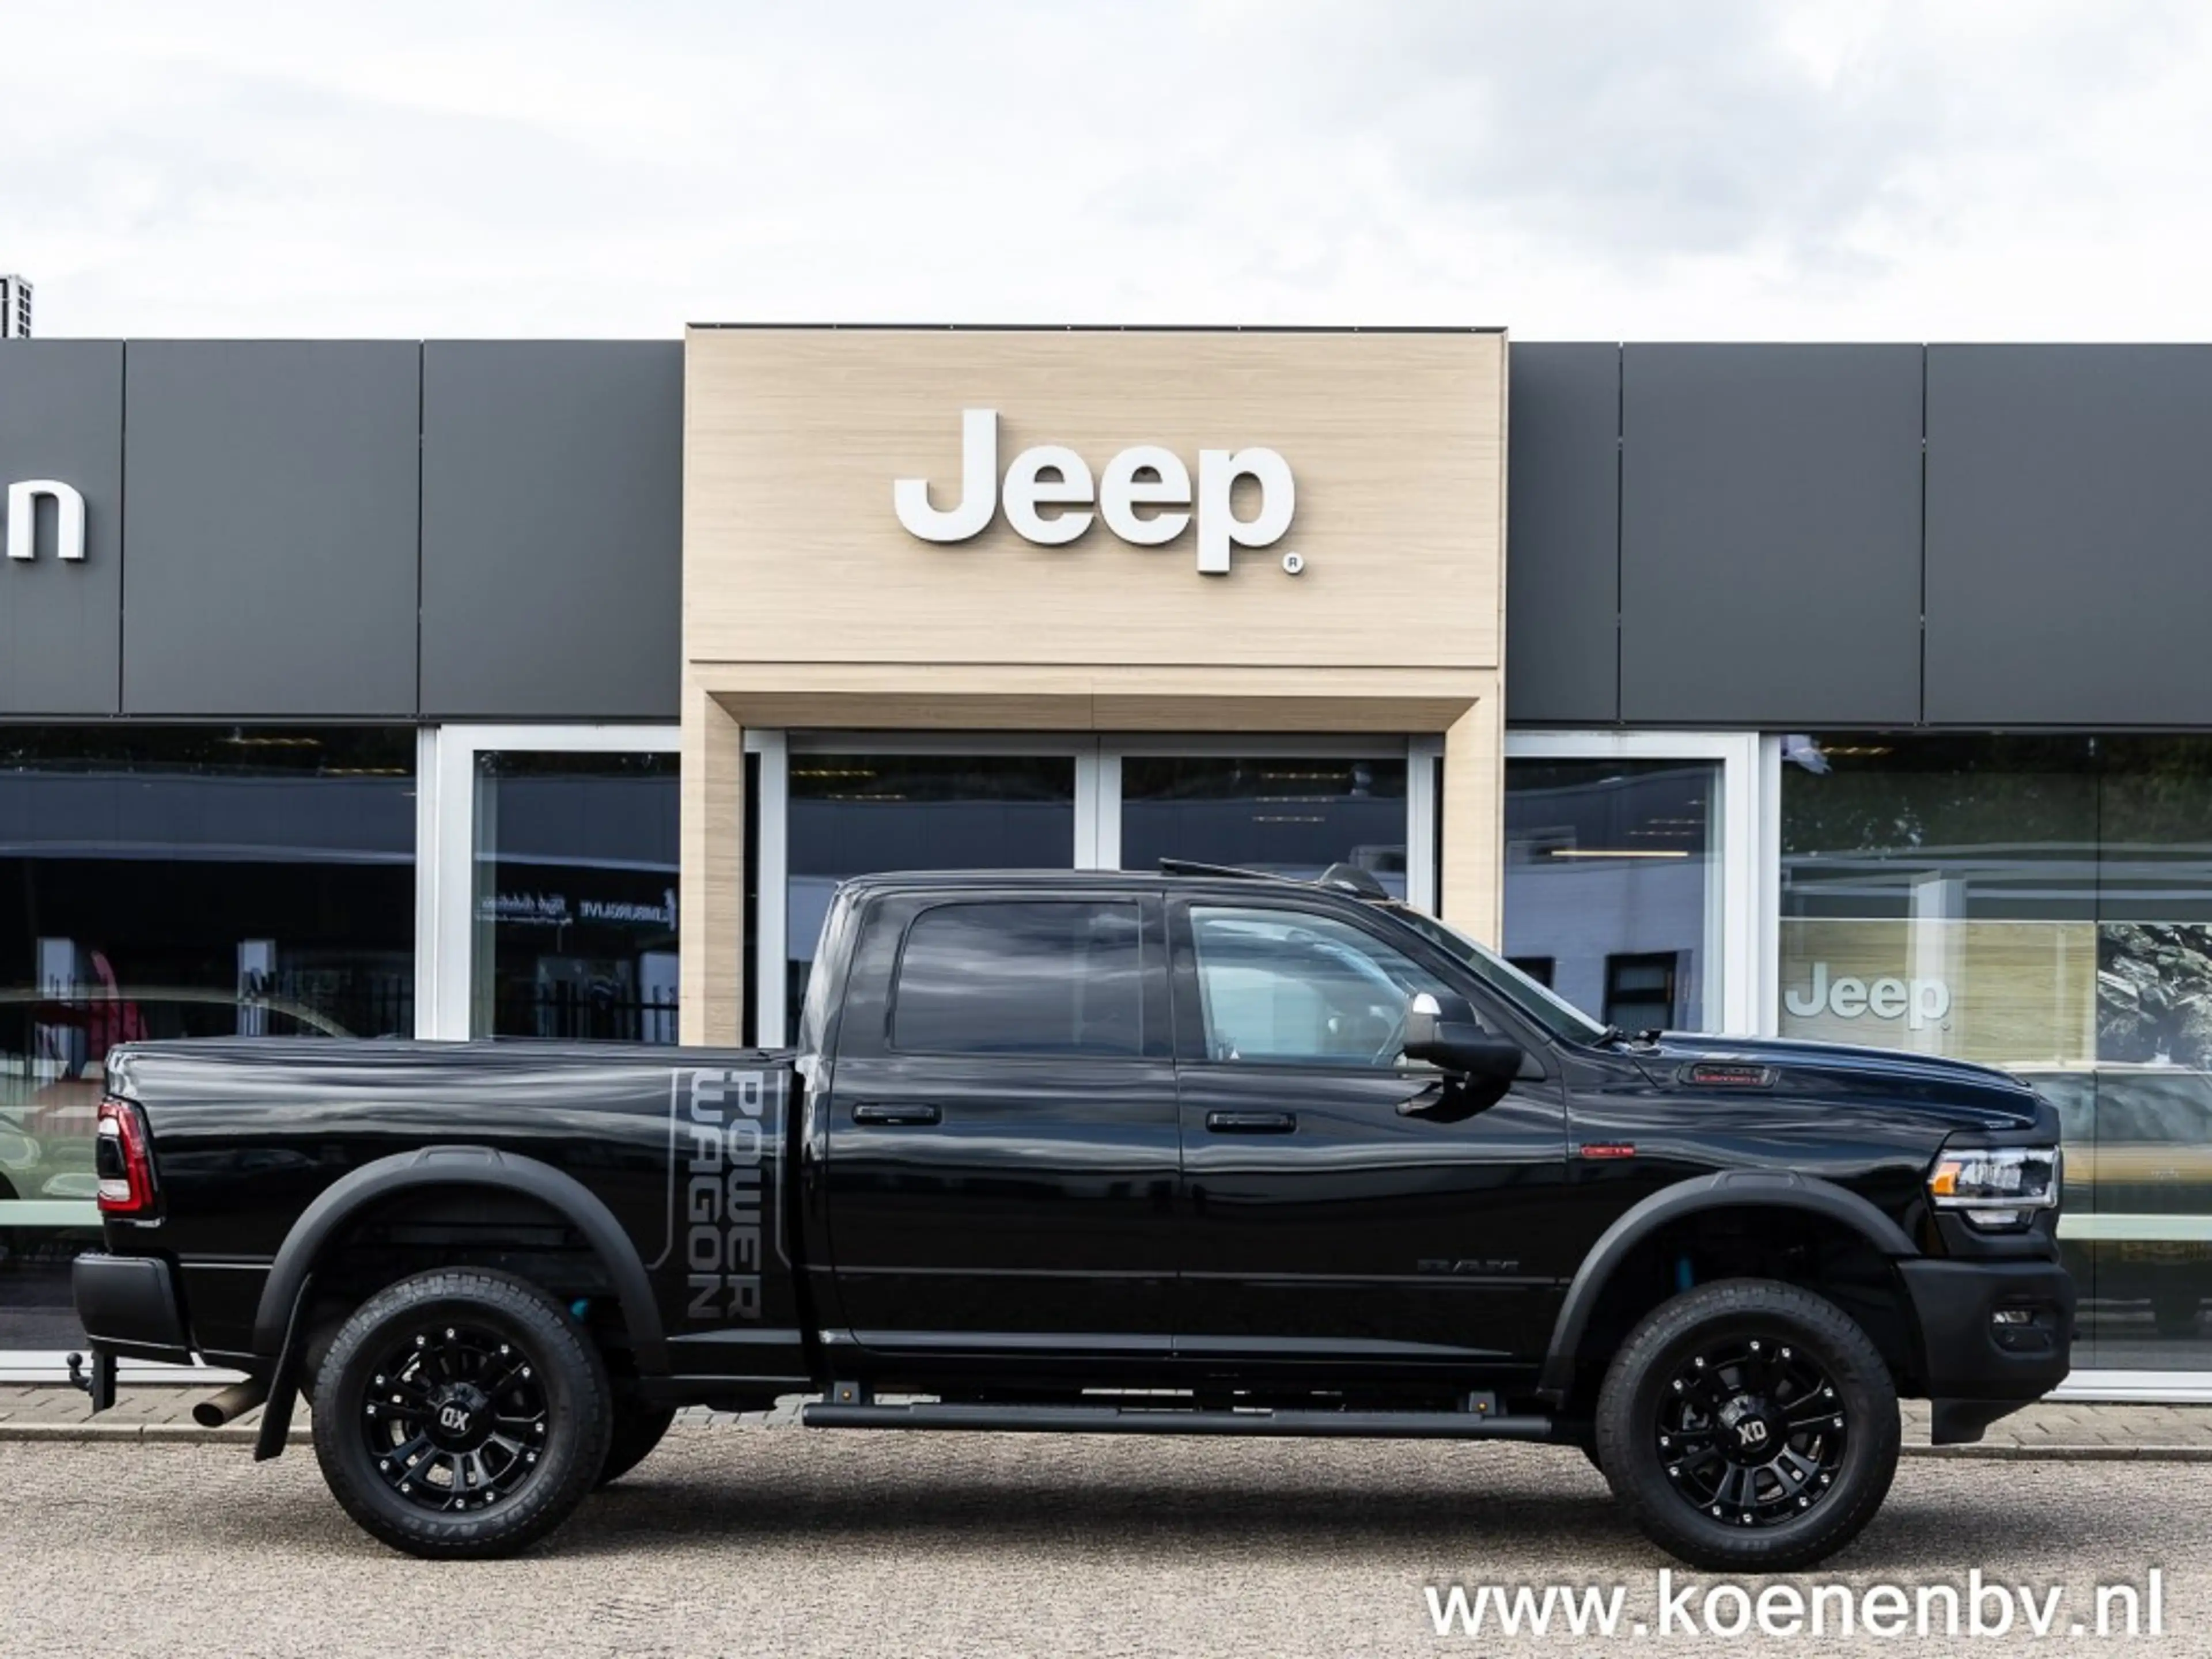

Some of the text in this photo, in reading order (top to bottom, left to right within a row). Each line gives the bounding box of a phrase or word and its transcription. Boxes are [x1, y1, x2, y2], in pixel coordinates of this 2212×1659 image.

[894, 409, 1296, 574] Jeep
[1784, 961, 1950, 1031] Jeep
[687, 1071, 724, 1319] WAGON
[727, 1071, 764, 1319] POWER
